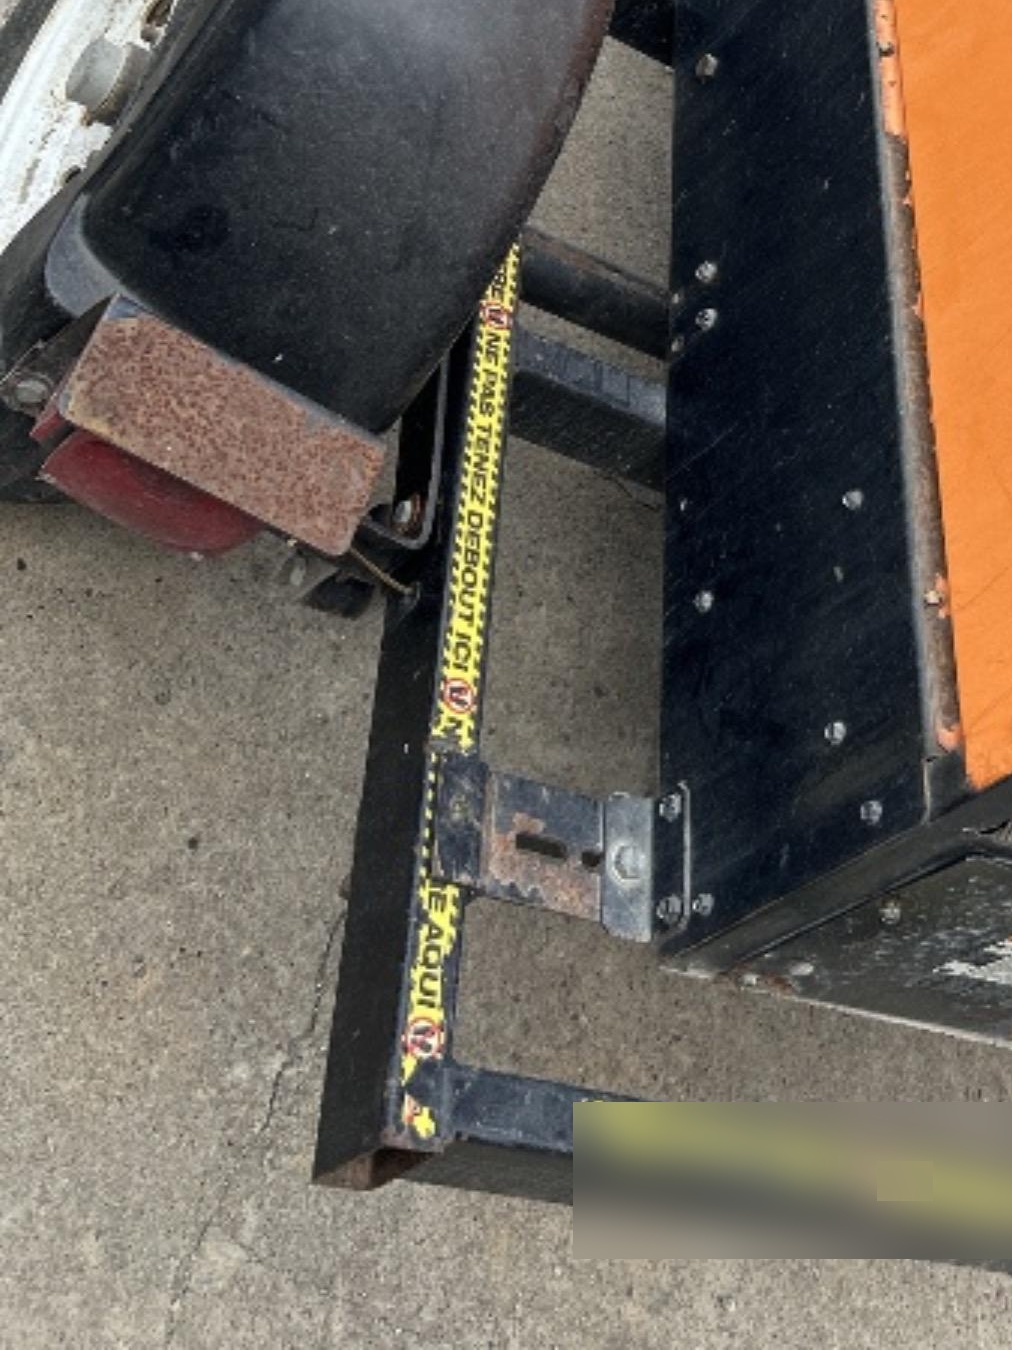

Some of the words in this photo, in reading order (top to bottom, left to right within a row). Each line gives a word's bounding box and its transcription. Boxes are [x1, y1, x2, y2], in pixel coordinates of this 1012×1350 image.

[482, 331, 502, 363] NE
[478, 369, 500, 418] PAS
[467, 422, 498, 509] TENEZ
[454, 512, 485, 626] DEBOUT
[452, 630, 476, 672] ICI
